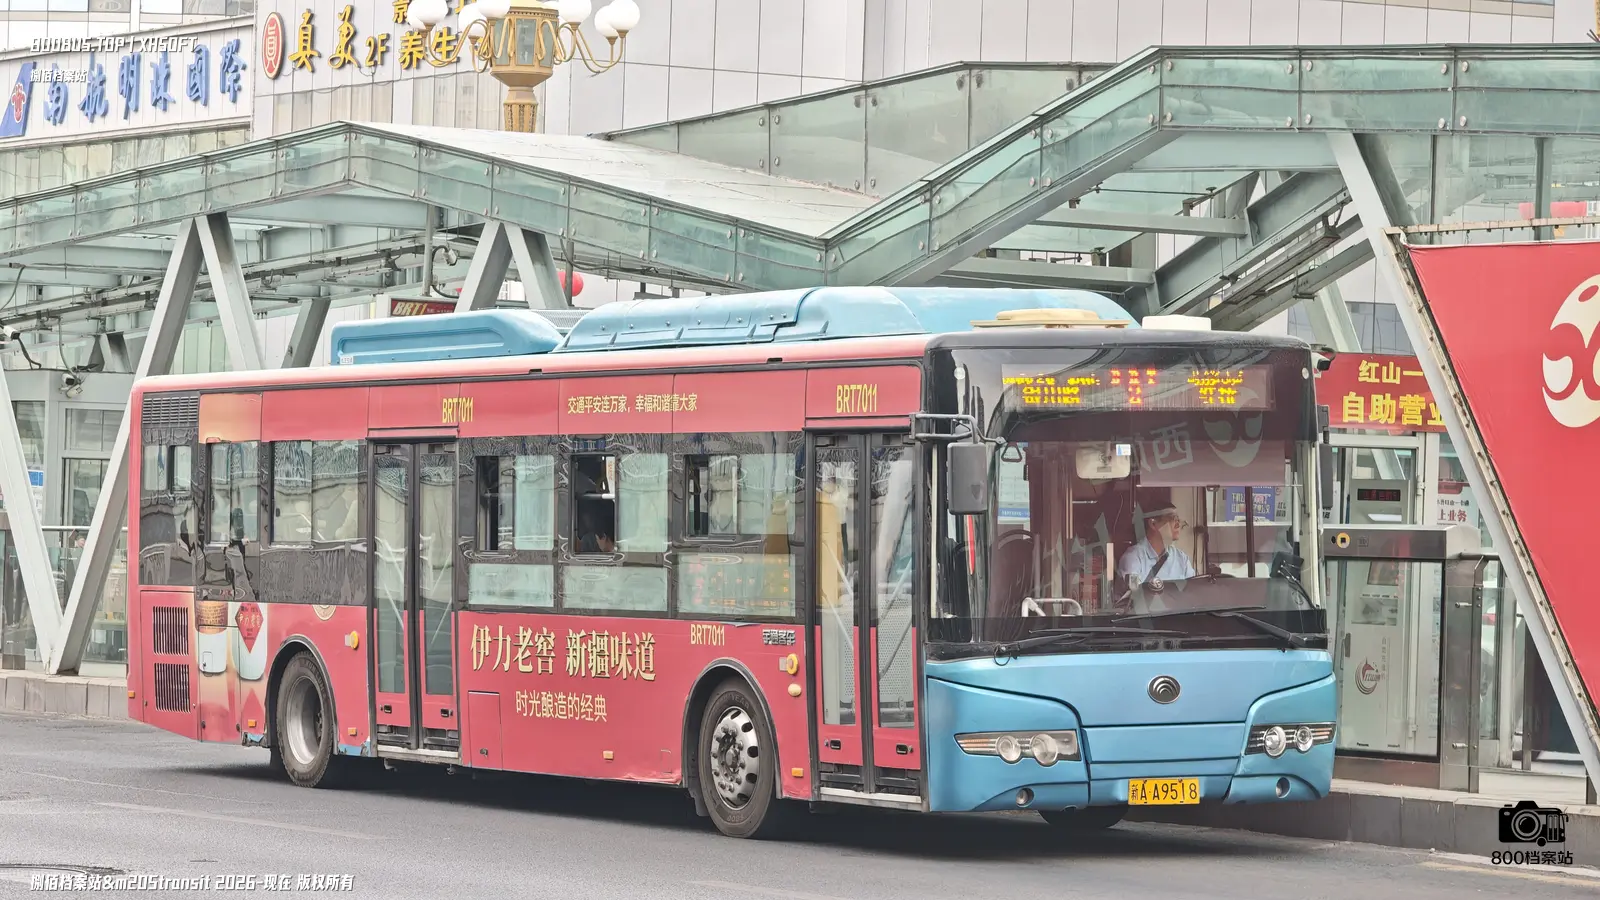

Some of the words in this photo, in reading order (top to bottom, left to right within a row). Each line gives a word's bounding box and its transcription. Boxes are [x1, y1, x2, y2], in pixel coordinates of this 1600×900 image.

[399, 26, 488, 69] 养生
[1358, 359, 1424, 385] 红山一
[441, 397, 474, 424] BRT7011
[635, 392, 698, 413] 幸福和谐靠大家
[835, 383, 878, 414] BRT7011
[690, 623, 725, 646] BRT7011
[470, 624, 556, 675] 伊力老窖
[565, 628, 656, 681] 新疆味道
[515, 689, 607, 722] 时光酿造的经典
